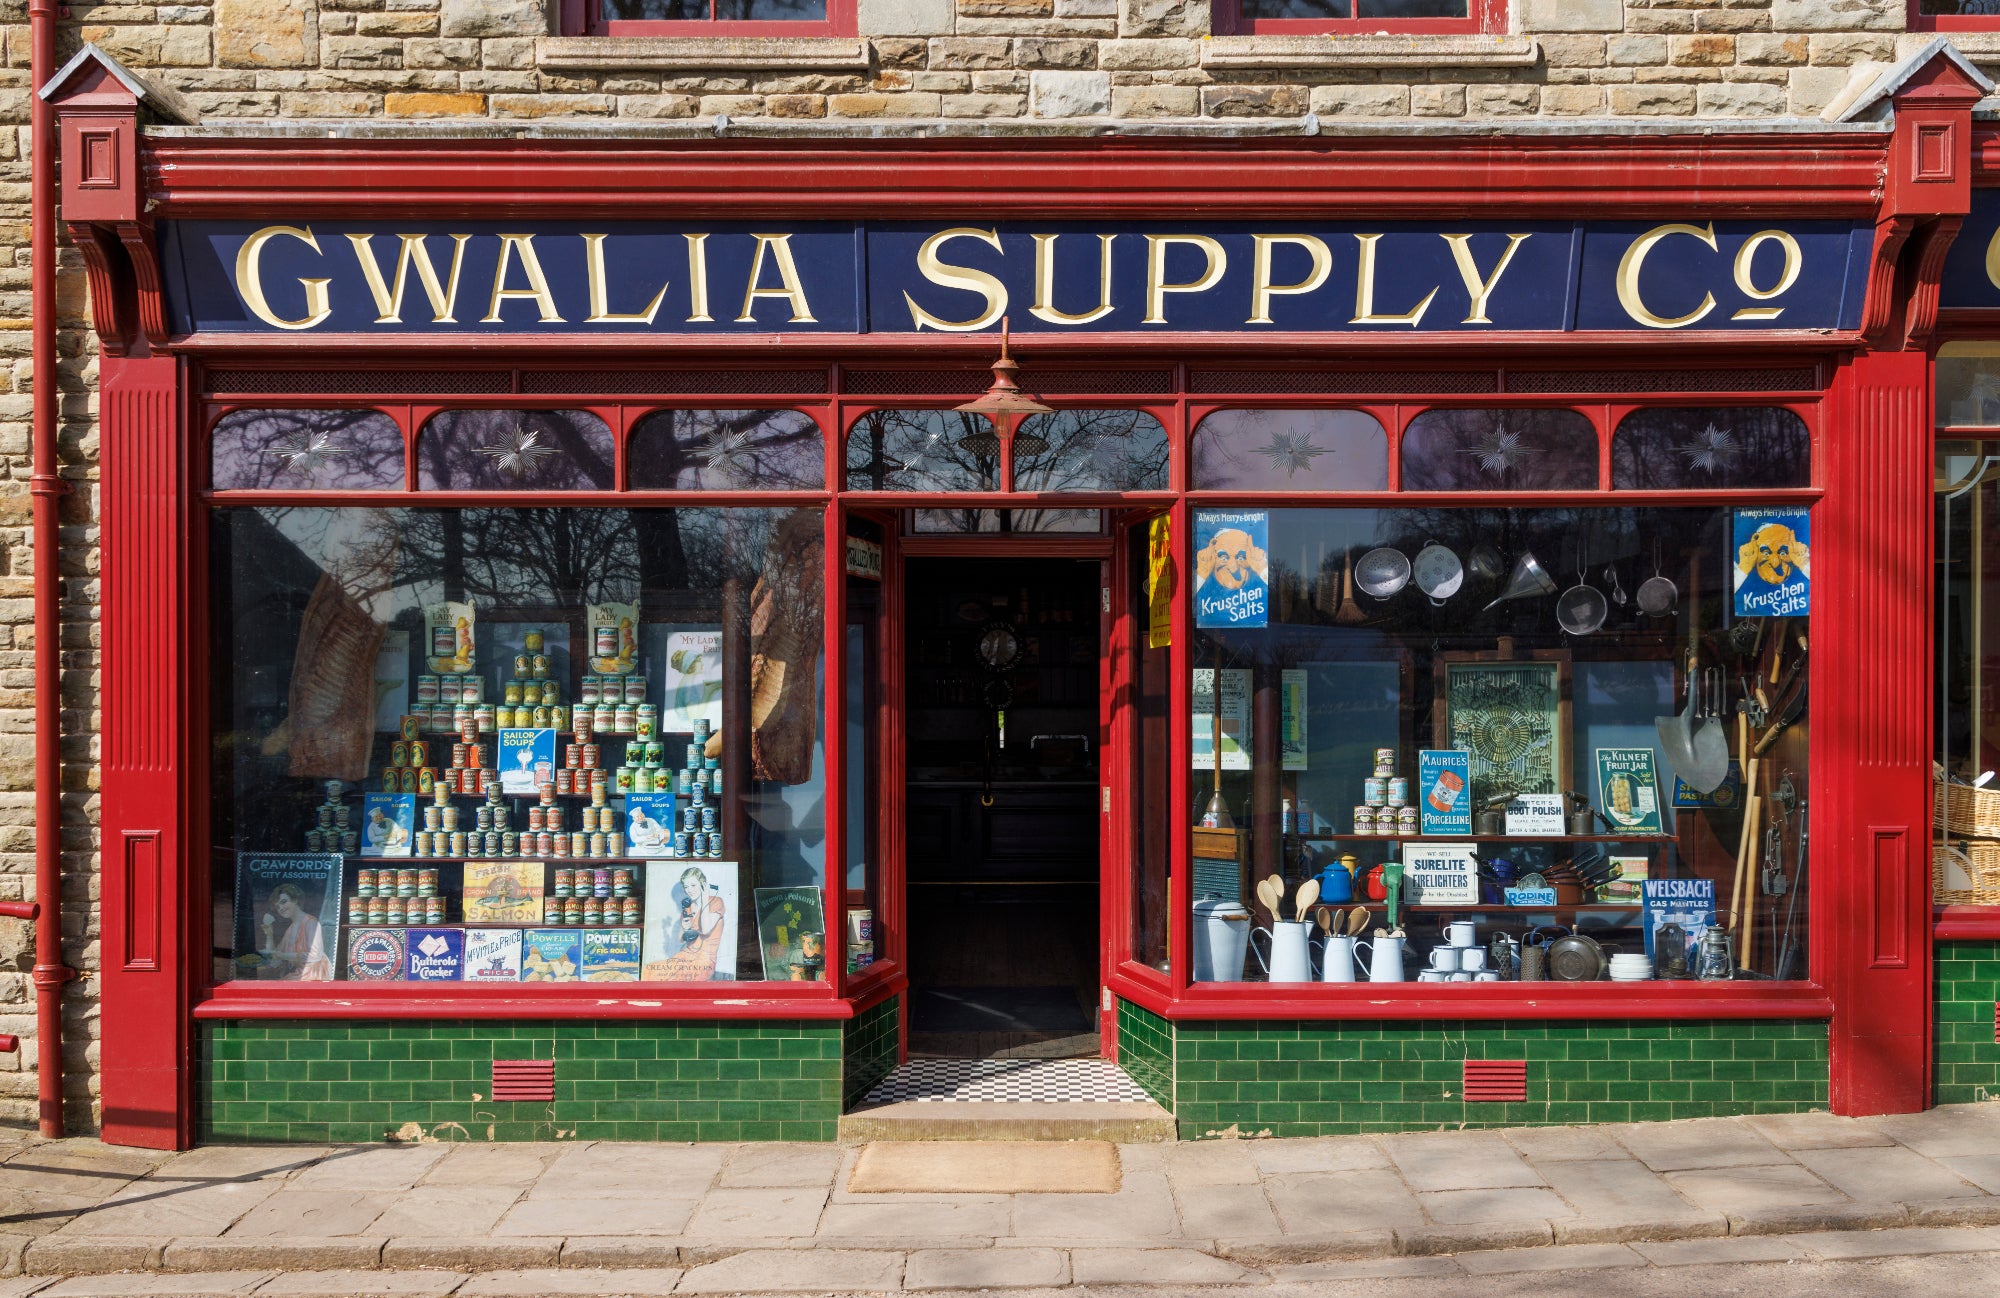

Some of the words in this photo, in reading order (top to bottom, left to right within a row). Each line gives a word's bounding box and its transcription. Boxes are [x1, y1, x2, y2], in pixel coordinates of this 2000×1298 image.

[235, 224, 819, 330] GWALIA
[903, 226, 1533, 332] SUPPLY
[1202, 587, 1262, 617] Kruschen
[1744, 582, 1804, 612] Kruschen
[600, 607, 614, 615] MY
[1229, 601, 1265, 622] Salts
[1772, 596, 1807, 617] Salts
[503, 739, 535, 747] SOUPS
[1422, 754, 1467, 766] MAURICE'S
[1607, 761, 1630, 771] FRUIT
[1630, 761, 1648, 771] JAR
[1679, 793, 1710, 801] PASTE
[1508, 806, 1530, 815] BOOT
[1532, 806, 1562, 815] POLISH
[1422, 813, 1470, 827] PORCELEINE
[250, 859, 332, 872] CRAWFORD'S
[475, 865, 511, 878] FRESH
[283, 871, 328, 879] ASSORTED
[1413, 874, 1468, 888] FIRELIGHTERS
[1645, 880, 1711, 898] WELSBACH
[761, 894, 783, 908] Brown
[788, 893, 816, 906] Polson's
[1509, 893, 1553, 904] RODINE
[1650, 900, 1667, 908] GAS
[468, 907, 536, 920] SALMON
[499, 931, 521, 950] PRICE
[532, 934, 575, 943] POWELL'S
[586, 933, 638, 944] POWELL'S
[358, 938, 375, 963] HUNTLEY
[380, 938, 396, 963] PALMERS
[361, 964, 392, 976] BISCUITS
[420, 966, 454, 979] Cracker
